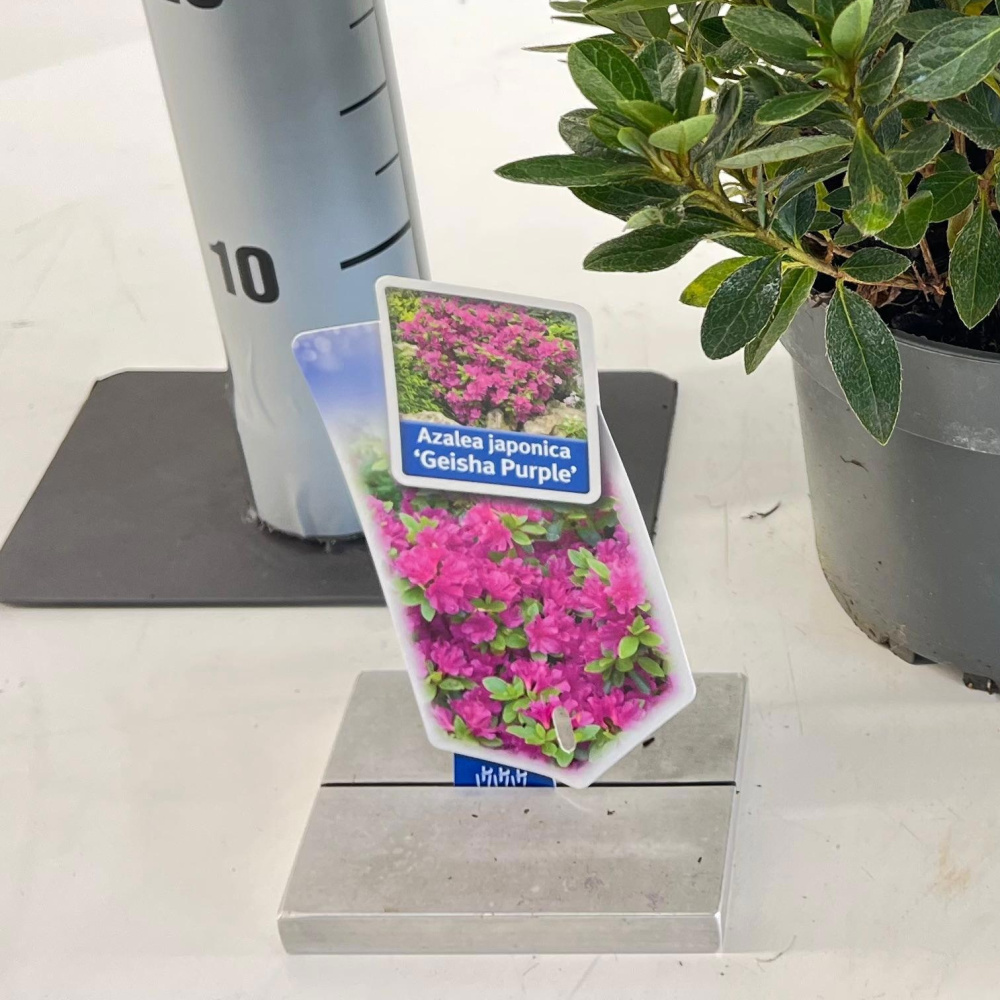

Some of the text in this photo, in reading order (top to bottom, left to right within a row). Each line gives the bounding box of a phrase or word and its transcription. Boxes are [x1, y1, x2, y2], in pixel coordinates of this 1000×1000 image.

[209, 240, 280, 304] 10
[417, 427, 572, 460] Azalea japonica
[413, 449, 578, 485] ‘Geisha Purple’
